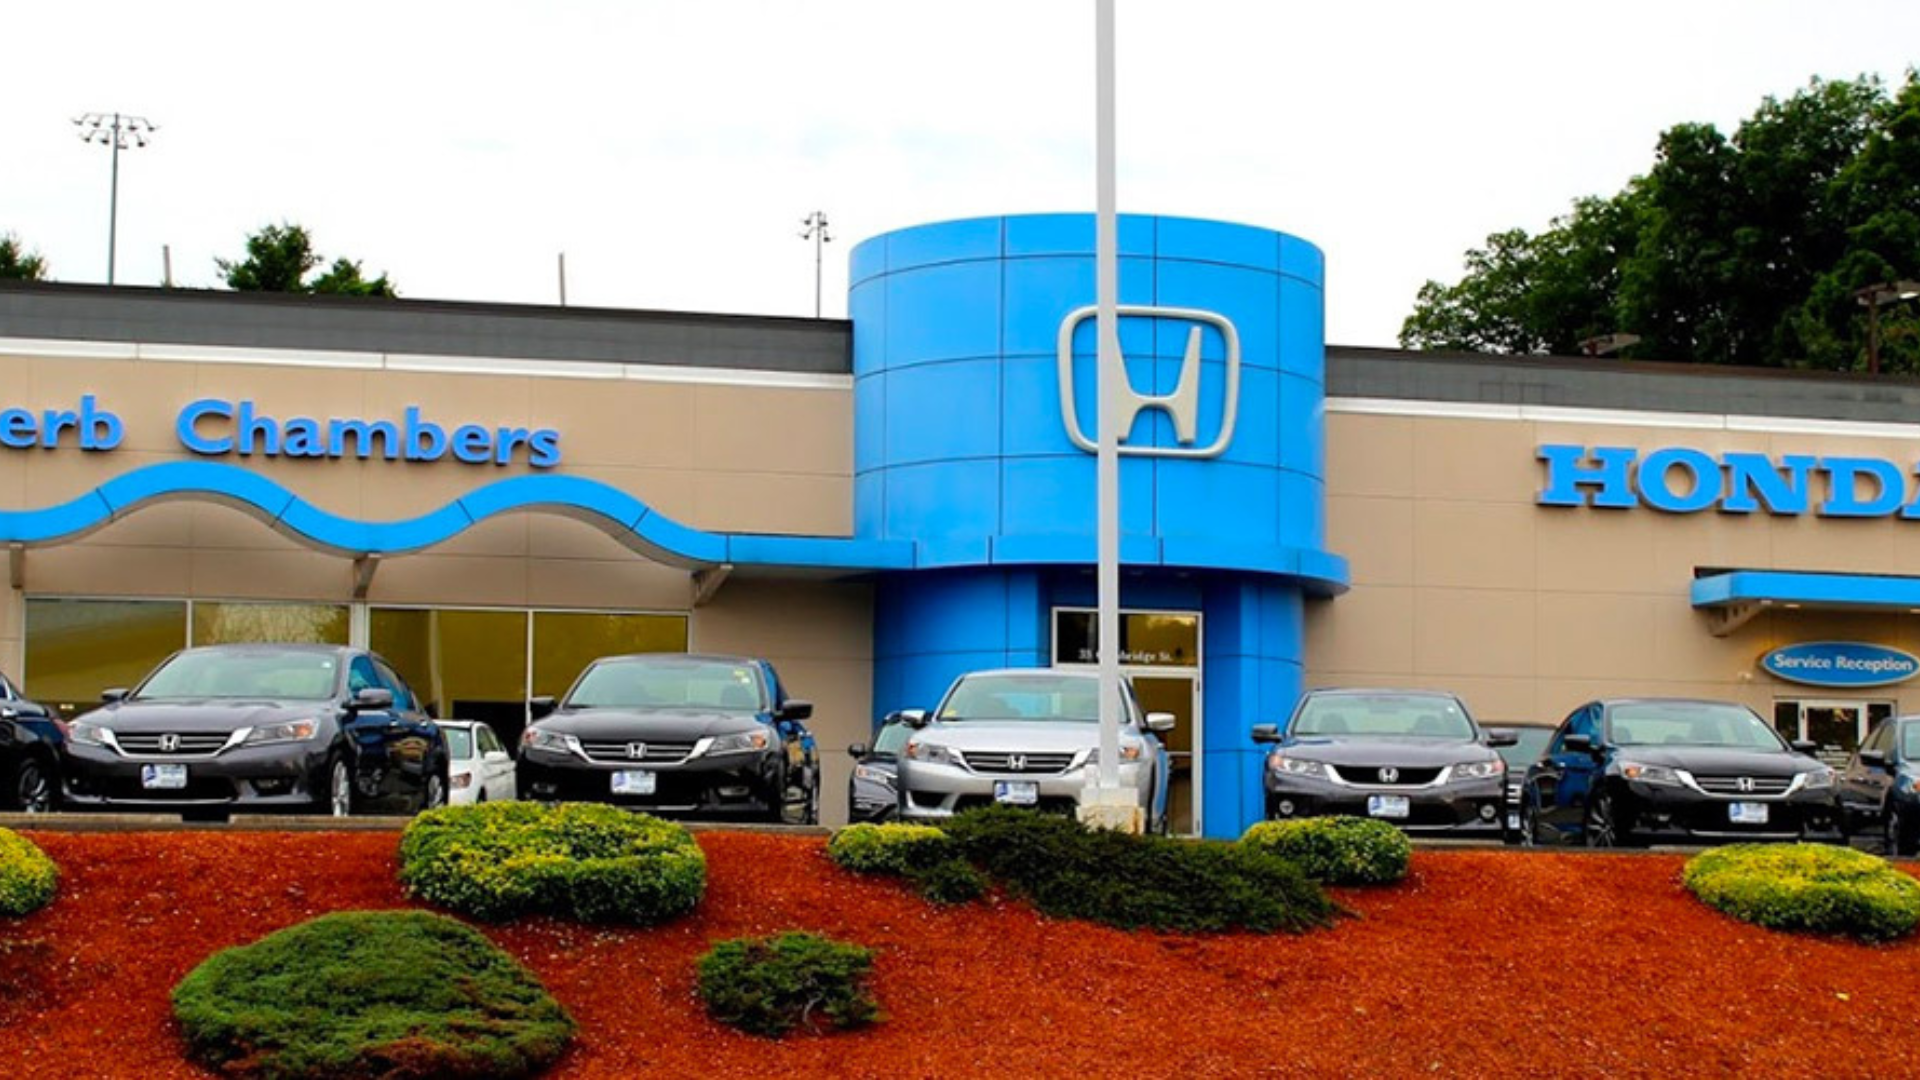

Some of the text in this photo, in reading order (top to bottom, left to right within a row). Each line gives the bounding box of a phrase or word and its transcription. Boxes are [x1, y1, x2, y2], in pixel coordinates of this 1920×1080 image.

[0, 394, 562, 467] erb Chambers
[1096, 649, 1157, 663] bridge
[1774, 653, 1913, 674] Service Reception
